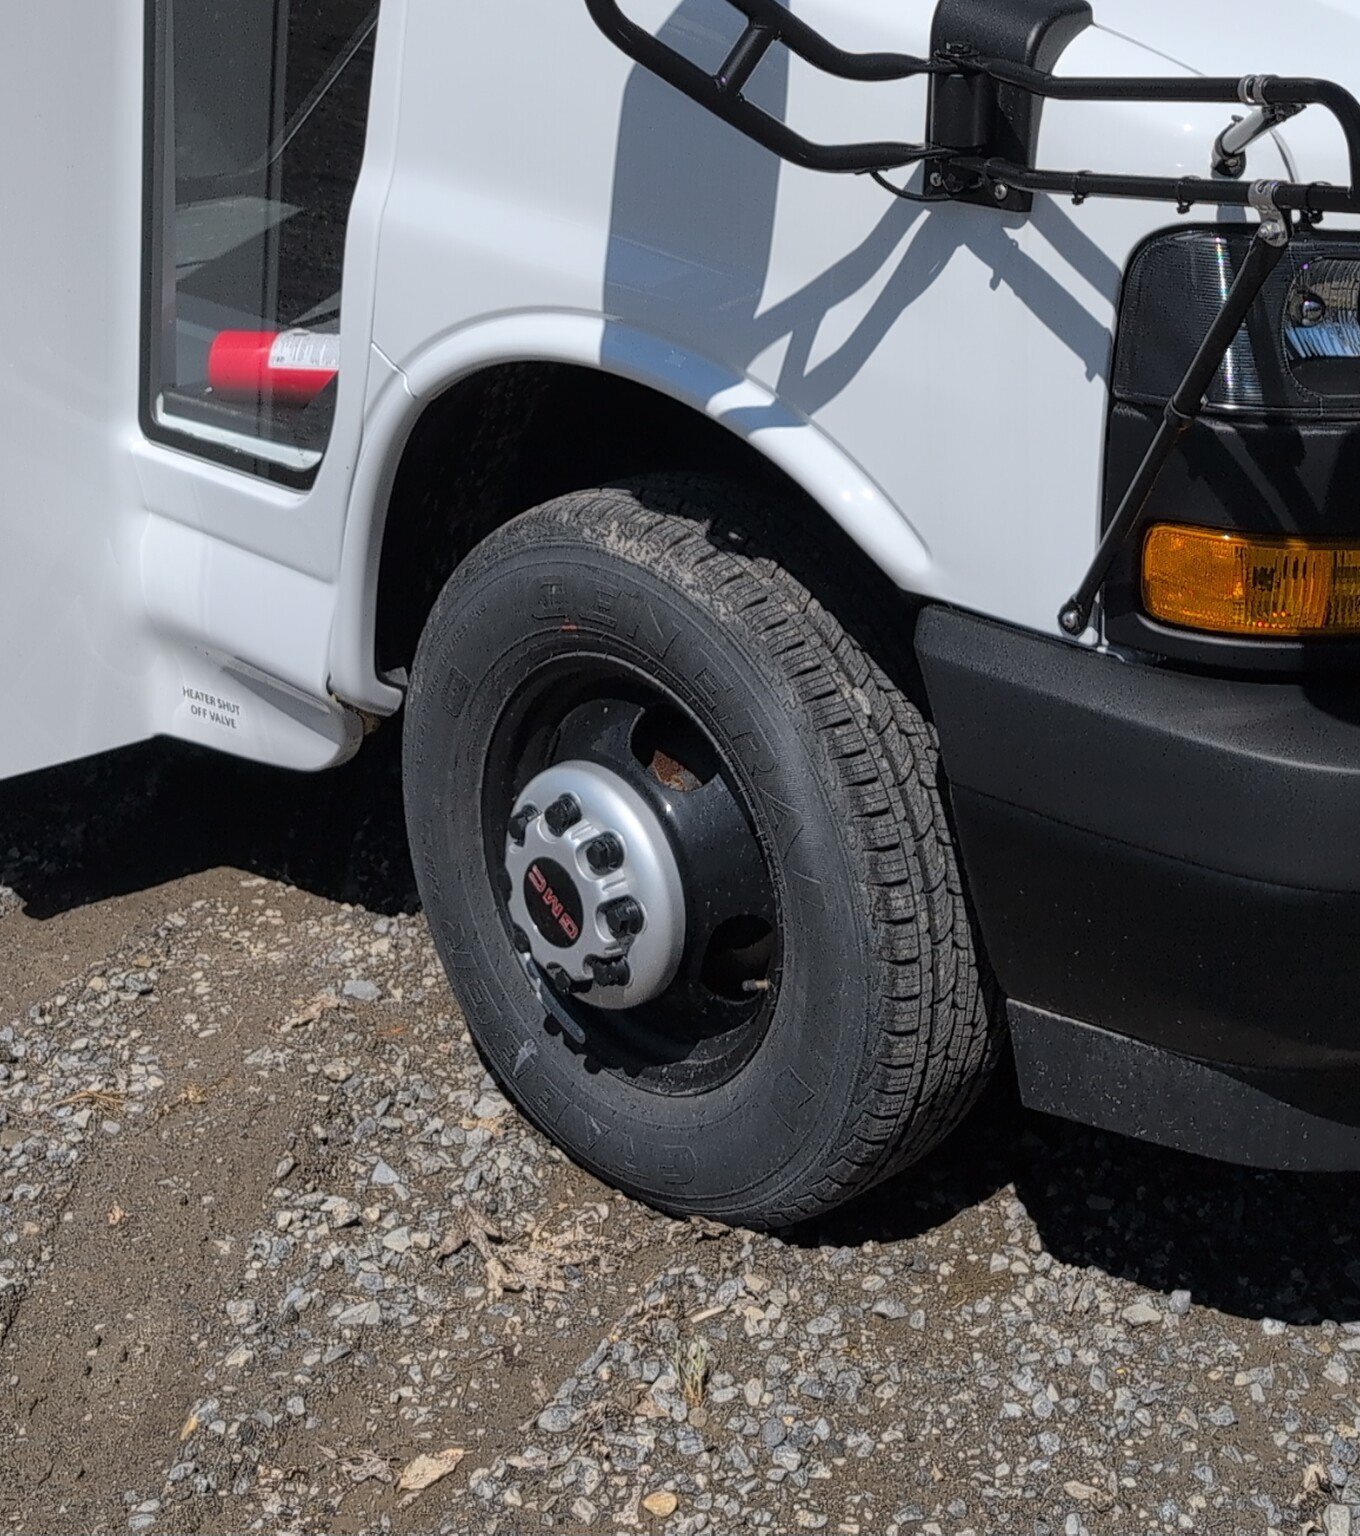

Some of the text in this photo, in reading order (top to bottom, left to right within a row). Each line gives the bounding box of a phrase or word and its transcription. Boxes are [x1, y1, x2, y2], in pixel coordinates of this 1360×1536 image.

[182, 685, 240, 716] HEATER SHUT
[190, 703, 237, 729] OFF VALVE
[527, 863, 579, 940] GMC
